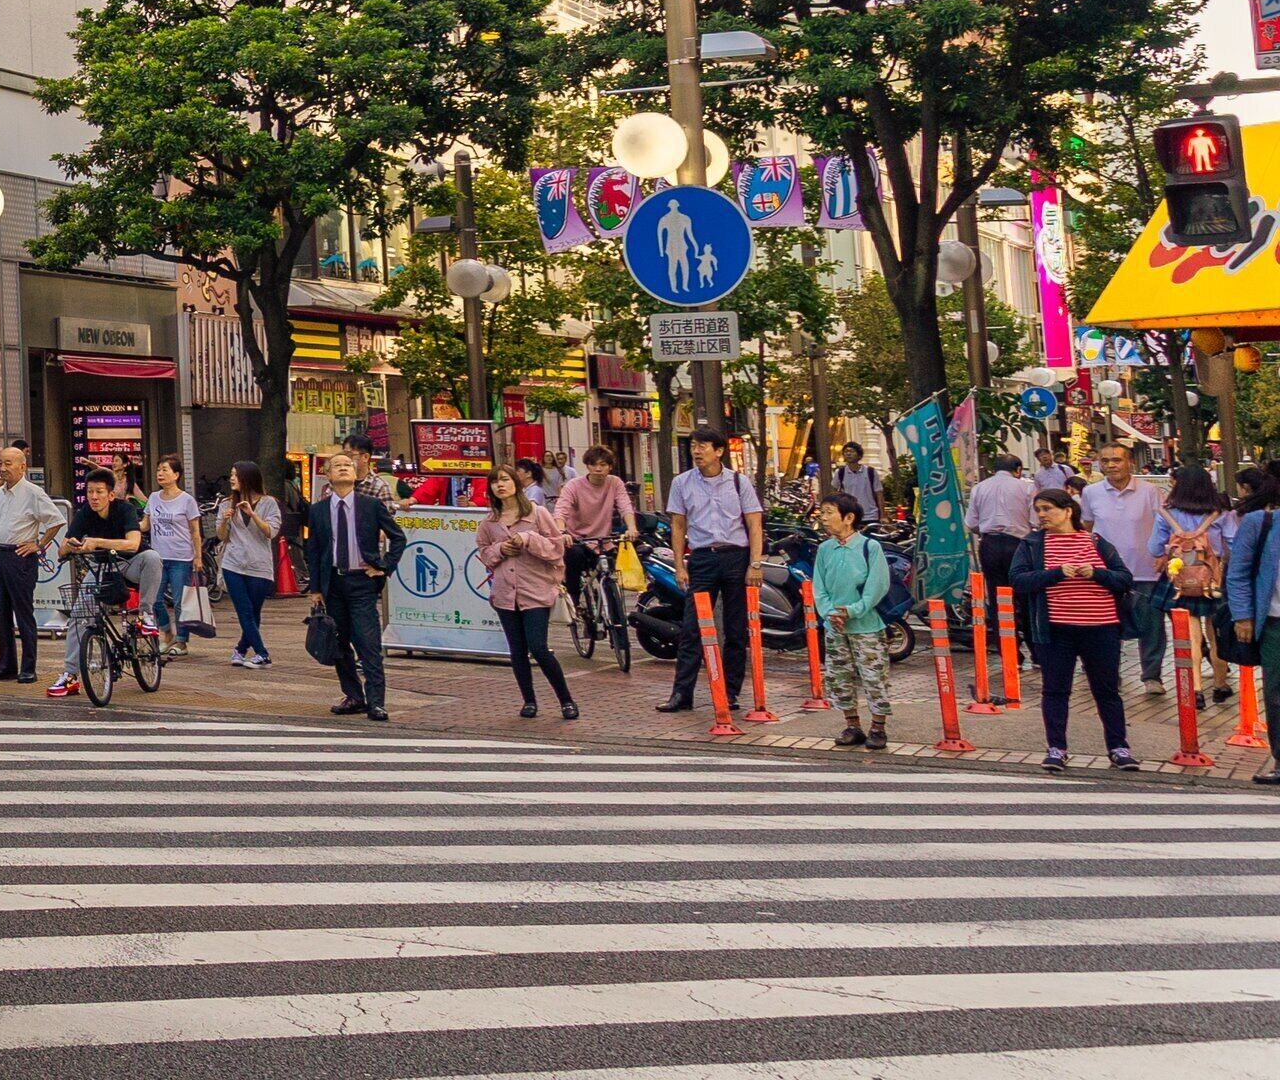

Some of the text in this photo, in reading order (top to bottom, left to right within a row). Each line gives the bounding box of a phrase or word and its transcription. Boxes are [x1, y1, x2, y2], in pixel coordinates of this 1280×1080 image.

[659, 317, 729, 335] 歩行者用道路
[78, 327, 135, 347] NEW ODEON
[660, 338, 731, 356] 特定禁止区間
